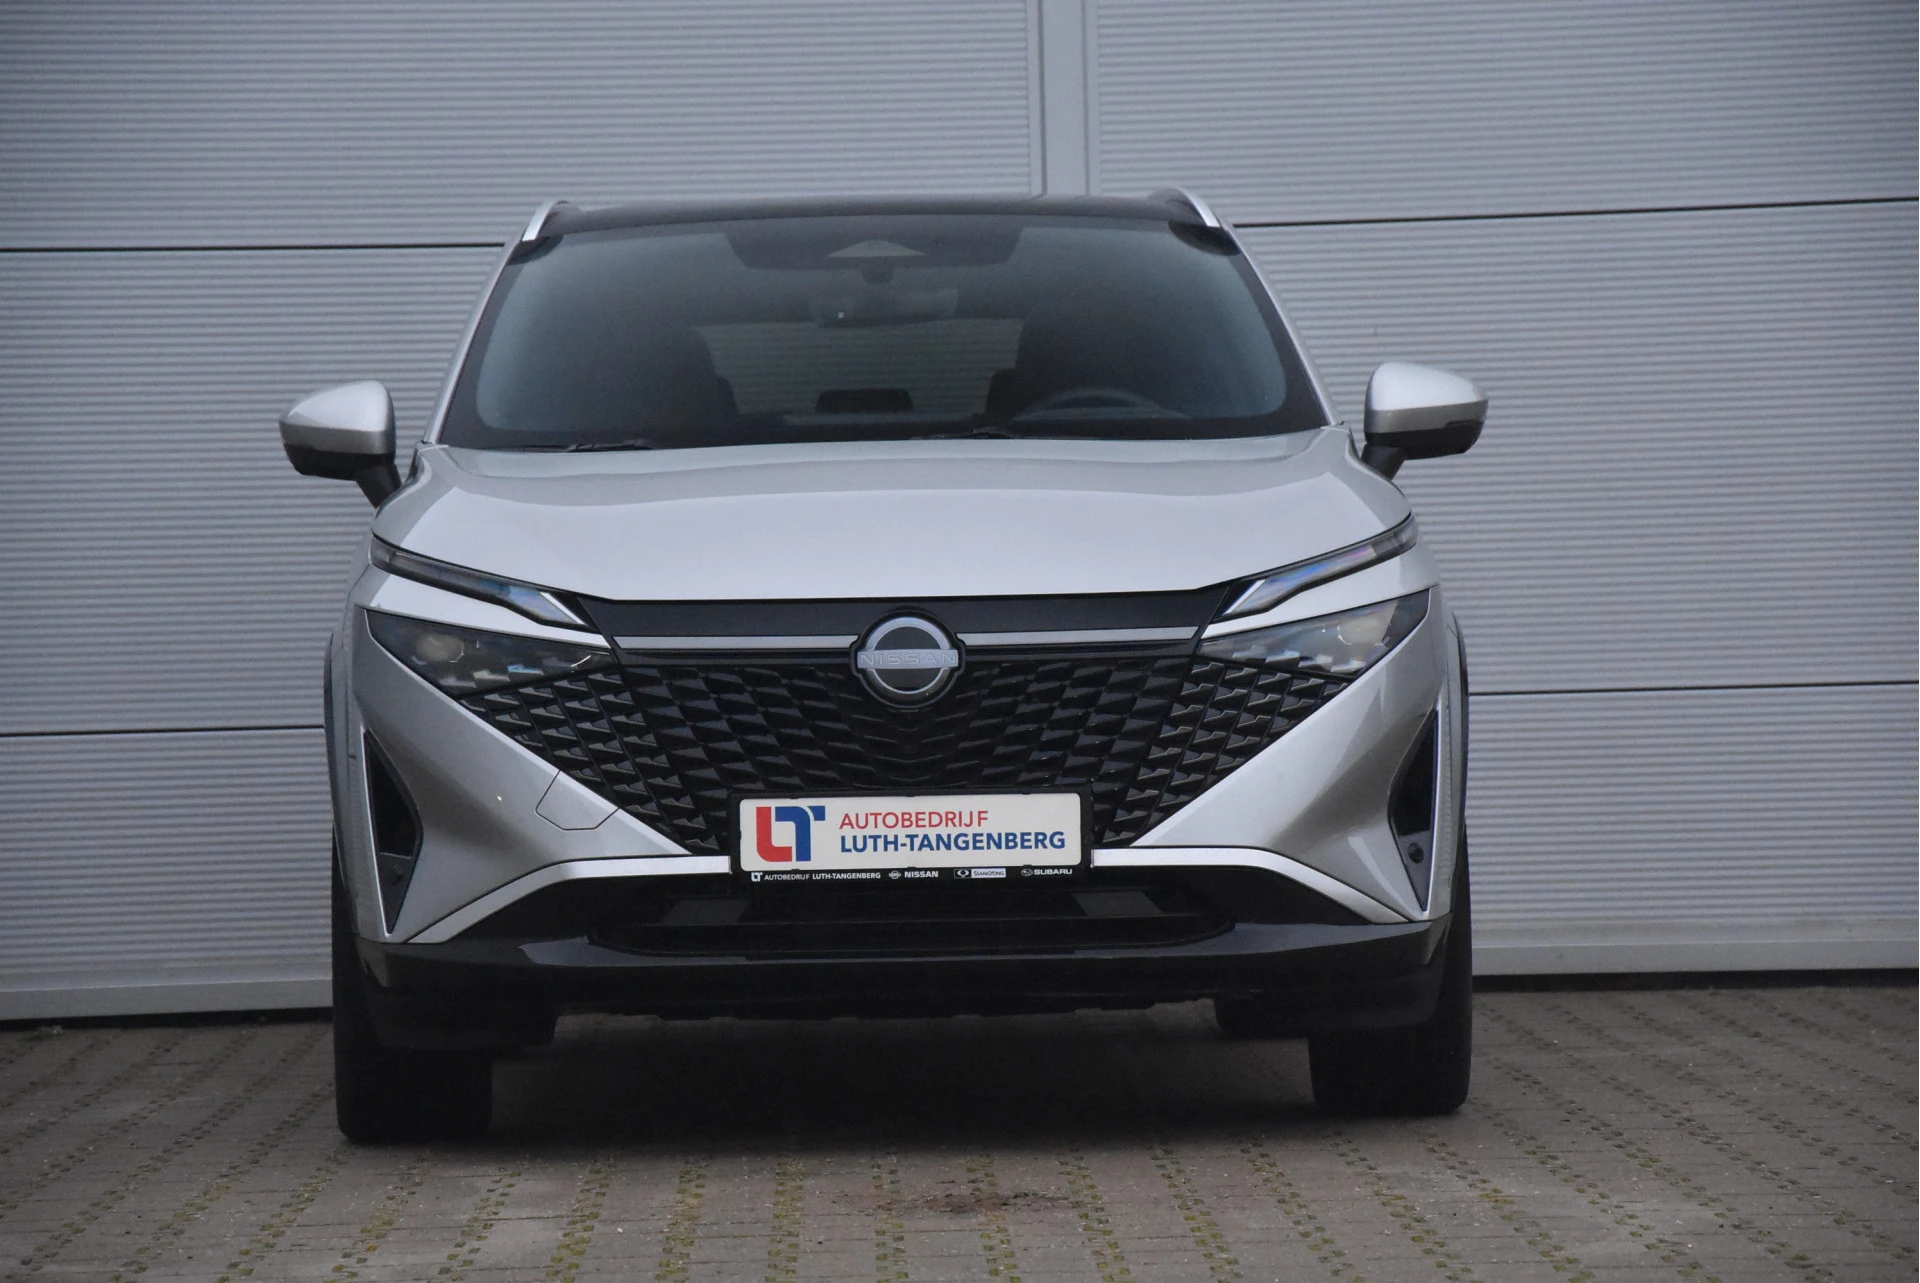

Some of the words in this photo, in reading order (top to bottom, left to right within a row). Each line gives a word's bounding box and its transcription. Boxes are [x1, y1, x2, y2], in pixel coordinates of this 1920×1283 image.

[860, 653, 956, 665] NISSAN
[839, 810, 989, 830] AUTOBEDRIJF
[840, 831, 1066, 853] LUTH-TANGENBERG
[764, 873, 810, 881] AUTOBEDRIJF
[812, 872, 881, 880] LUTH-TANGENBERG
[904, 870, 939, 878] NISSAN
[1033, 868, 1073, 876] SUBARU
